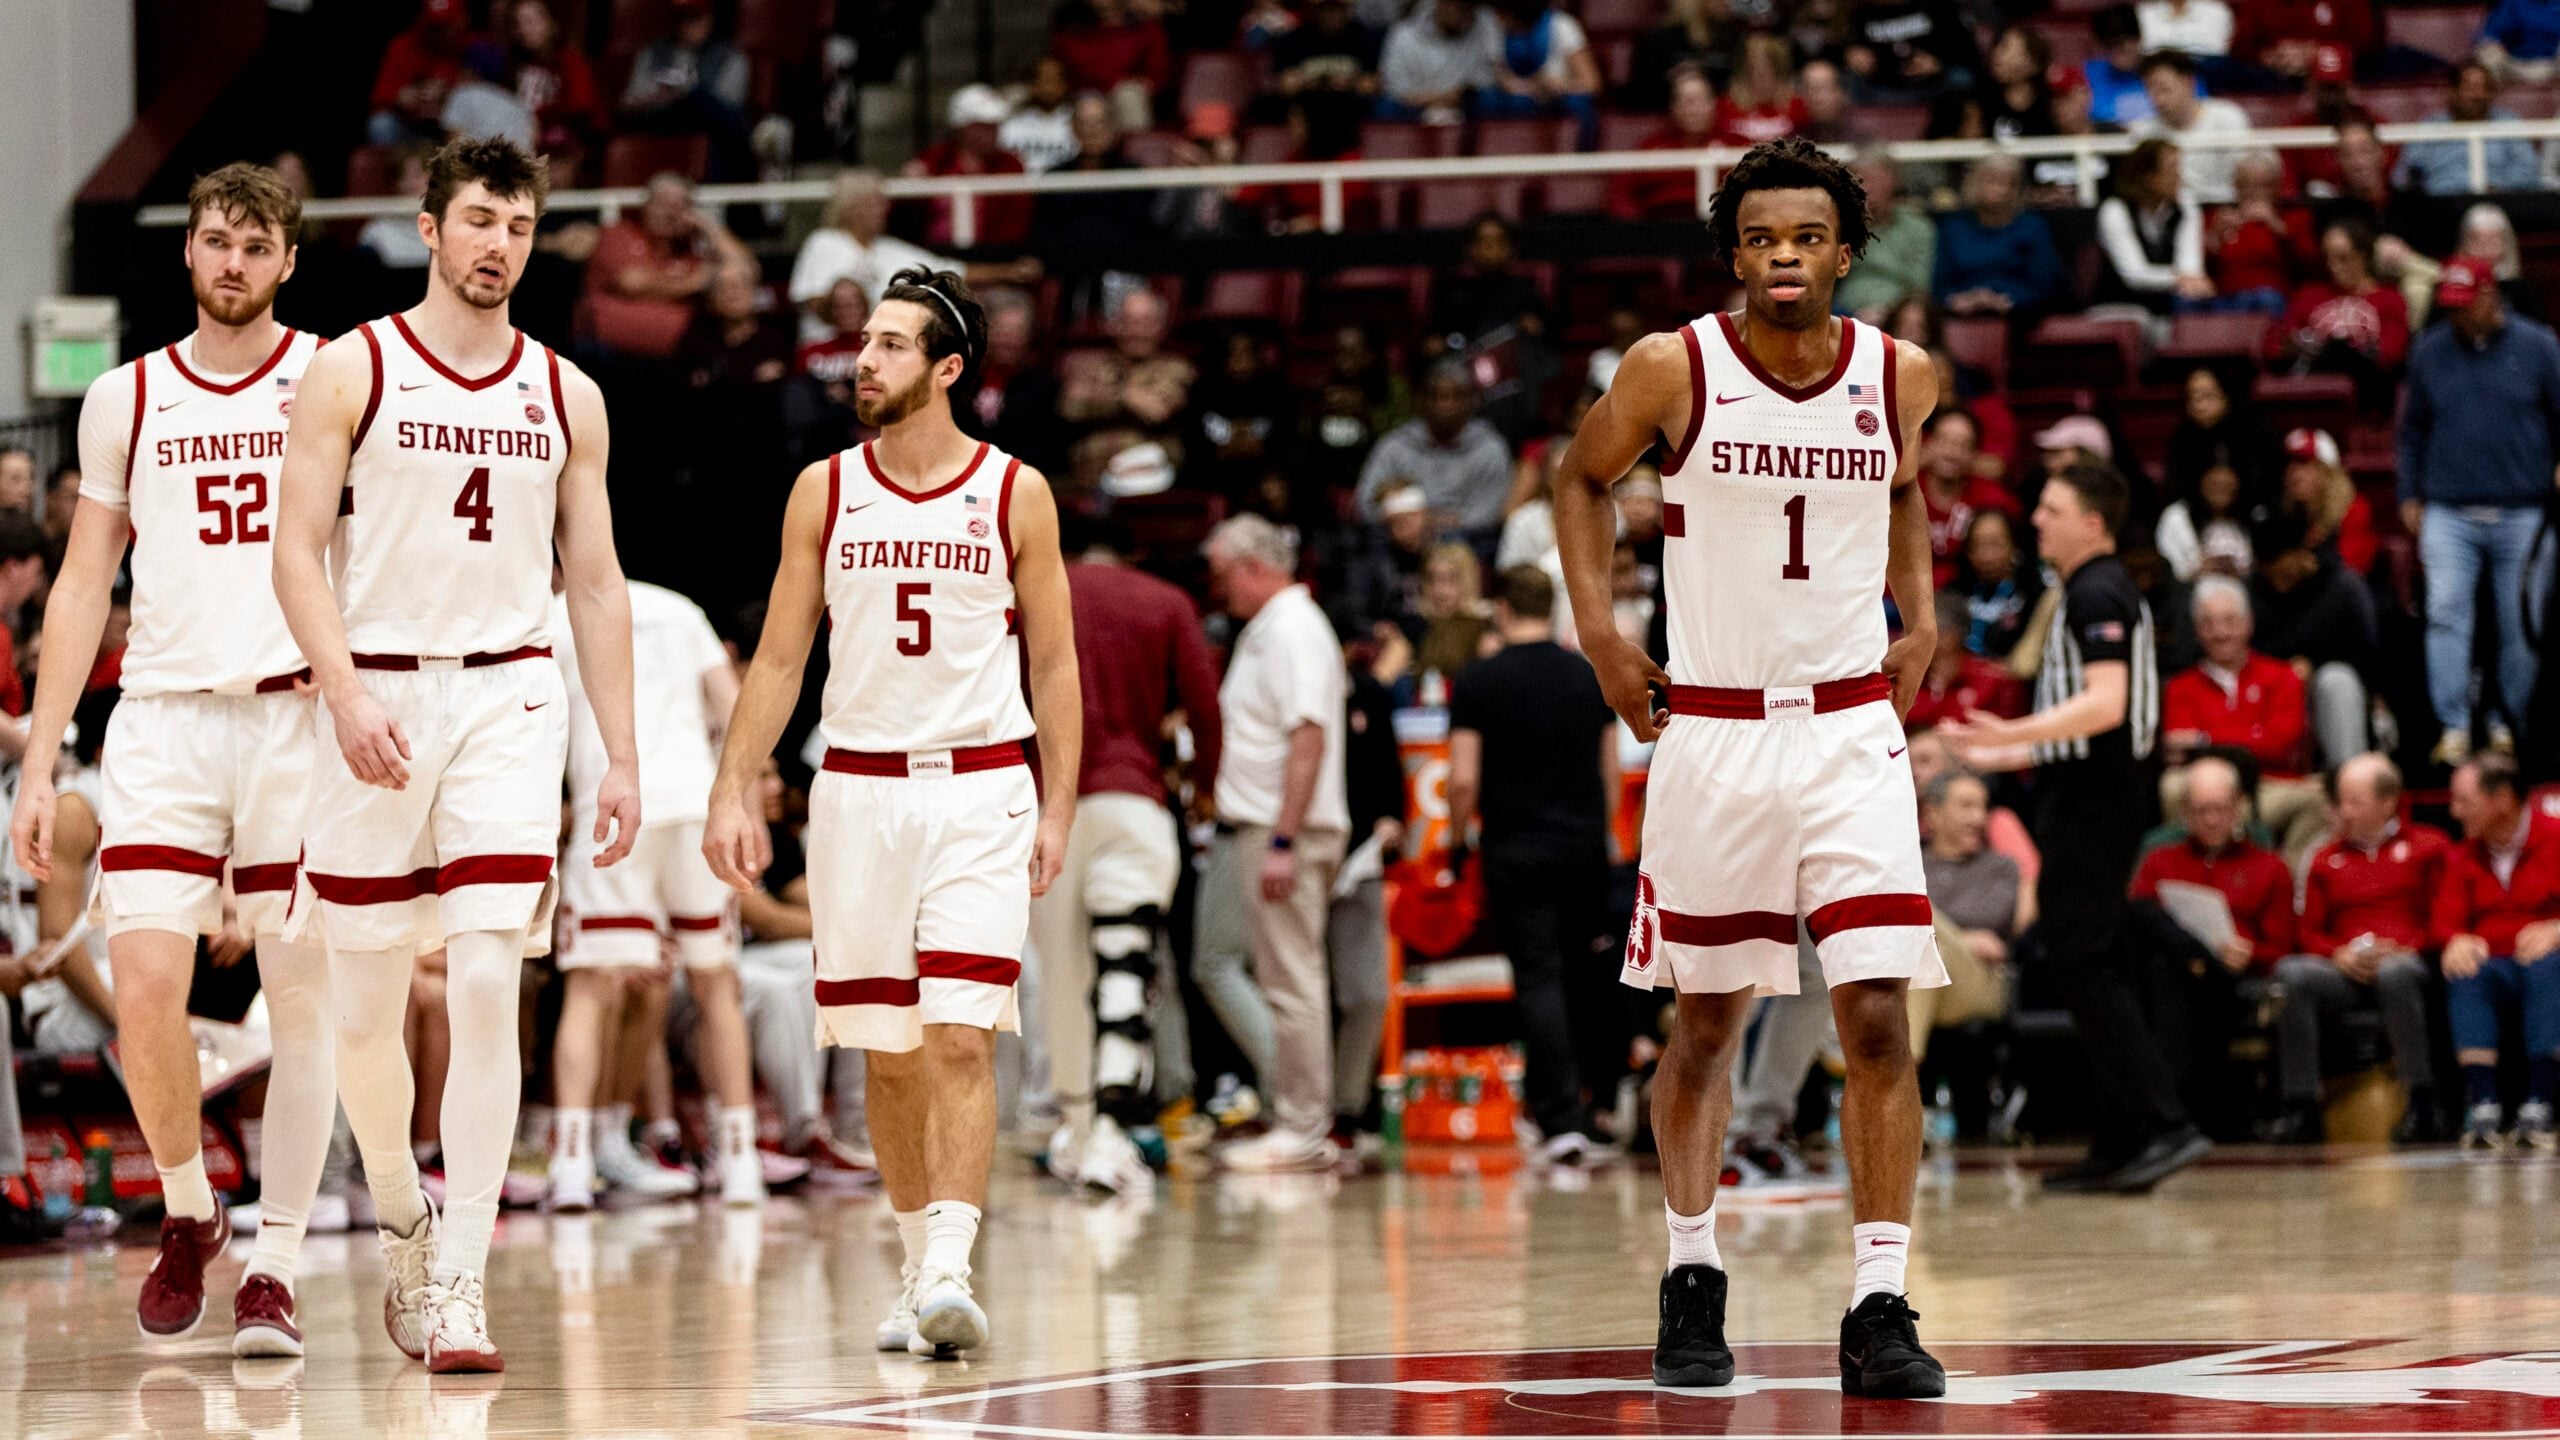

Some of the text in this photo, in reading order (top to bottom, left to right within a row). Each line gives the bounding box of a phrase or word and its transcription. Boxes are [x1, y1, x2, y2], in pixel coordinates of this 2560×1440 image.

[157, 431, 289, 467] STANFOR
[398, 421, 551, 462] STANFORD
[1712, 441, 1886, 481] STANFORD
[196, 472, 270, 545] 52
[453, 467, 494, 542] 4
[1782, 494, 1810, 580] 1
[841, 541, 991, 575] STANFORD
[896, 582, 931, 656] 5
[1769, 697, 1810, 709] CARDINAL
